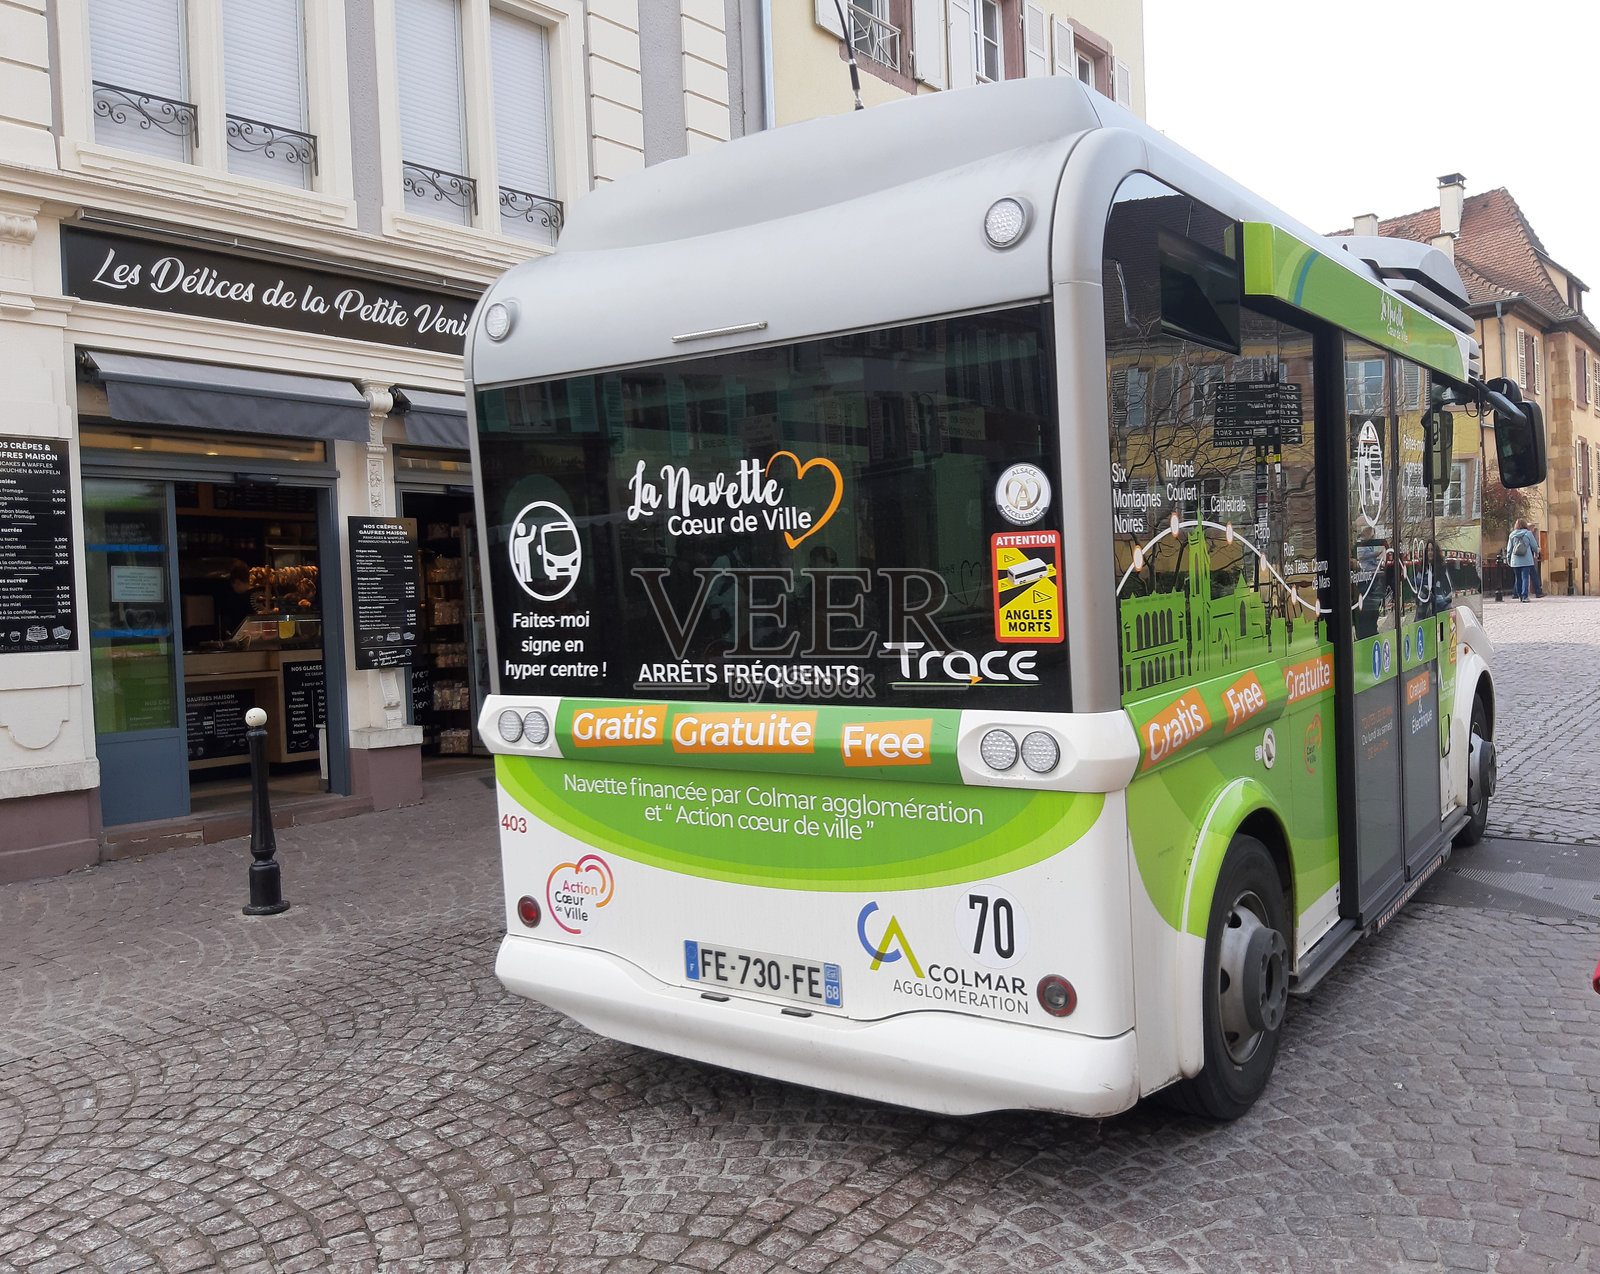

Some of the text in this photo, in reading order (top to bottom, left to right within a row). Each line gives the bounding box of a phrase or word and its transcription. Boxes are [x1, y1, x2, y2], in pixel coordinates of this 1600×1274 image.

[93, 248, 469, 337] Les Délices de la Petite Veni
[10, 441, 42, 450] CRÊPES
[25, 453, 58, 461] MAISON
[1011, 467, 1038, 478] ALSACE
[1112, 462, 1127, 482] Six
[1165, 460, 1195, 478] Marché
[627, 459, 784, 522] La Navette
[1166, 484, 1197, 501] Couvert
[1112, 490, 1162, 512] Montagnes
[667, 506, 812, 537] Cœur de Ville
[1004, 504, 1041, 519] EXCELLENCE
[1114, 515, 1144, 534] Noires
[996, 534, 1056, 546] ATTENTION
[512, 611, 590, 629] Faites-moi
[1005, 609, 1053, 621] ANGLES
[1008, 622, 1051, 632] MORTS
[521, 637, 584, 656] signe en
[505, 660, 547, 680] hyper
[549, 662, 599, 677] centre
[638, 660, 860, 688] ARRÊTS FRÉQUENTS
[1148, 661, 1330, 761] Gratis Free Gratuite
[572, 711, 926, 759] Gratis Gratuite Free
[563, 773, 984, 826] Navette financée par Colmar agglomération
[501, 813, 528, 834] 403
[644, 803, 662, 822] et
[737, 815, 788, 834] cœur
[793, 815, 819, 836] de
[562, 879, 598, 896] Action
[555, 890, 585, 906] Cœur
[564, 906, 589, 923] Ville
[969, 893, 1015, 960] 70
[700, 948, 823, 999] FE-730-FE
[826, 984, 840, 1001] 68
[928, 964, 1028, 997] COLMAR
[893, 979, 1029, 1015] AGGLOMÉRATION
